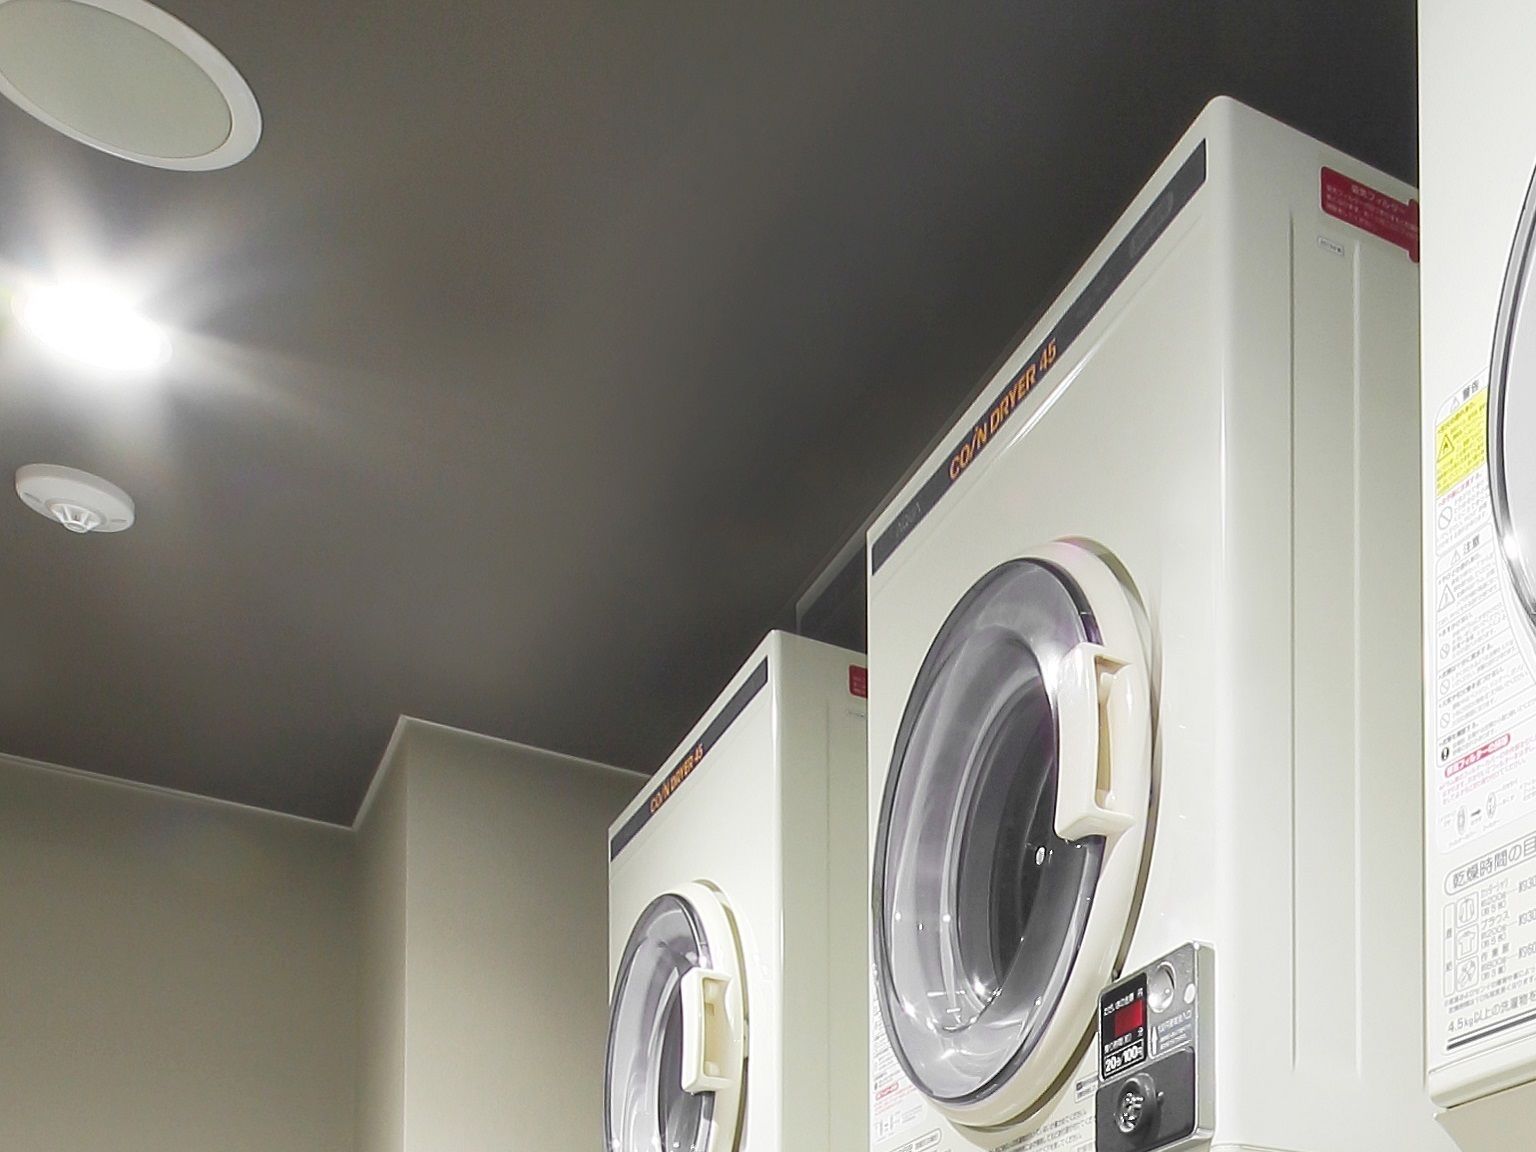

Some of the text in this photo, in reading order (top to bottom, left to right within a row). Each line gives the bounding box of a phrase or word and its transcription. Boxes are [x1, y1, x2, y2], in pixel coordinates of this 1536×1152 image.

[949, 337, 1057, 480] COIN DRYER 45
